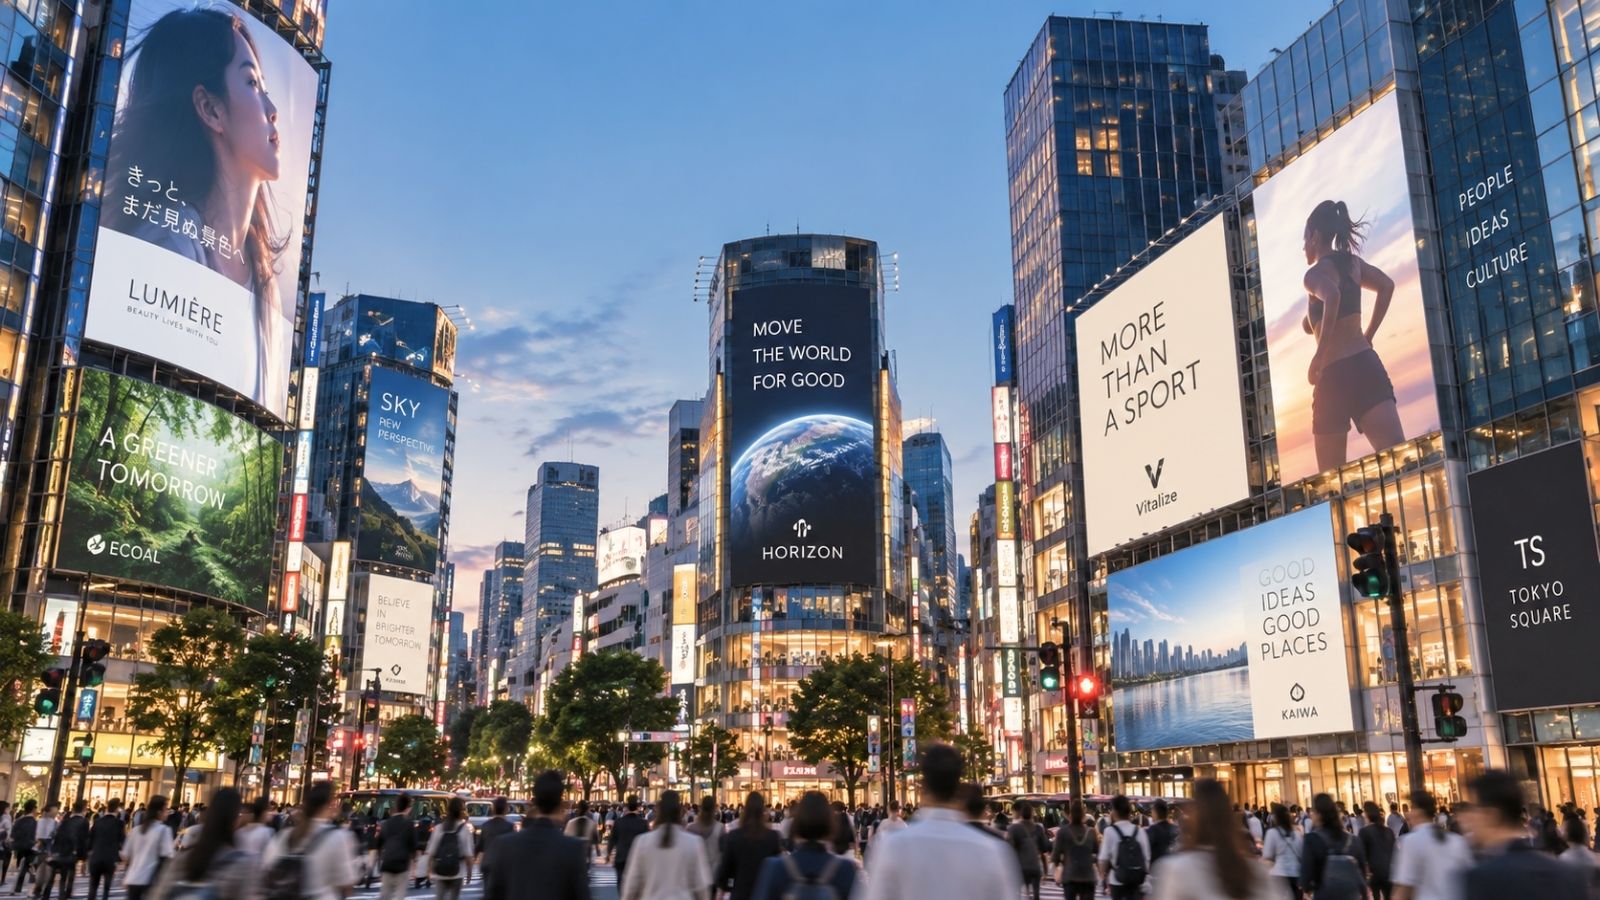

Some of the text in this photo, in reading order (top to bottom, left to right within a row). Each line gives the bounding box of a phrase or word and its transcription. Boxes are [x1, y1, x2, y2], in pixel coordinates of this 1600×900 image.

[128, 165, 186, 206] きっと、
[1458, 164, 1514, 212] PEOPLE
[123, 194, 244, 265] まだ見ぬ景色へ
[1465, 208, 1509, 249] IDEAS
[1466, 242, 1529, 288] CULTURE
[127, 305, 159, 321] BEAUTY
[162, 316, 184, 331] LIVES
[186, 326, 203, 340] WITH
[753, 318, 803, 337] MOVE
[1101, 301, 1166, 366] MORE
[752, 344, 852, 364] THE WORLD
[753, 371, 845, 391] FOR GOOD
[1101, 339, 1168, 399] THAN
[381, 392, 421, 419] SKY
[1104, 359, 1201, 437] A SPORT
[99, 426, 218, 479] A GREENER
[378, 428, 436, 455] PERSPECTIVE
[97, 458, 226, 511] TOMORROW
[1135, 491, 1178, 516] Vitalize
[109, 540, 161, 565] ECOAL
[762, 545, 843, 560] HORIZON
[1513, 535, 1546, 569] TS
[1258, 556, 1315, 587] GOOD
[378, 594, 411, 609] BELIEVE
[1261, 582, 1316, 612] IDEAS
[1509, 580, 1564, 605] TOKYO
[377, 609, 387, 619] IN
[1262, 607, 1321, 636] GOOD
[1509, 603, 1572, 629] SQUARE
[374, 634, 422, 651] TOMORROW
[375, 622, 416, 636] BRIGHTER
[1261, 631, 1328, 661] PLACES
[1281, 705, 1319, 720] KAIWA
